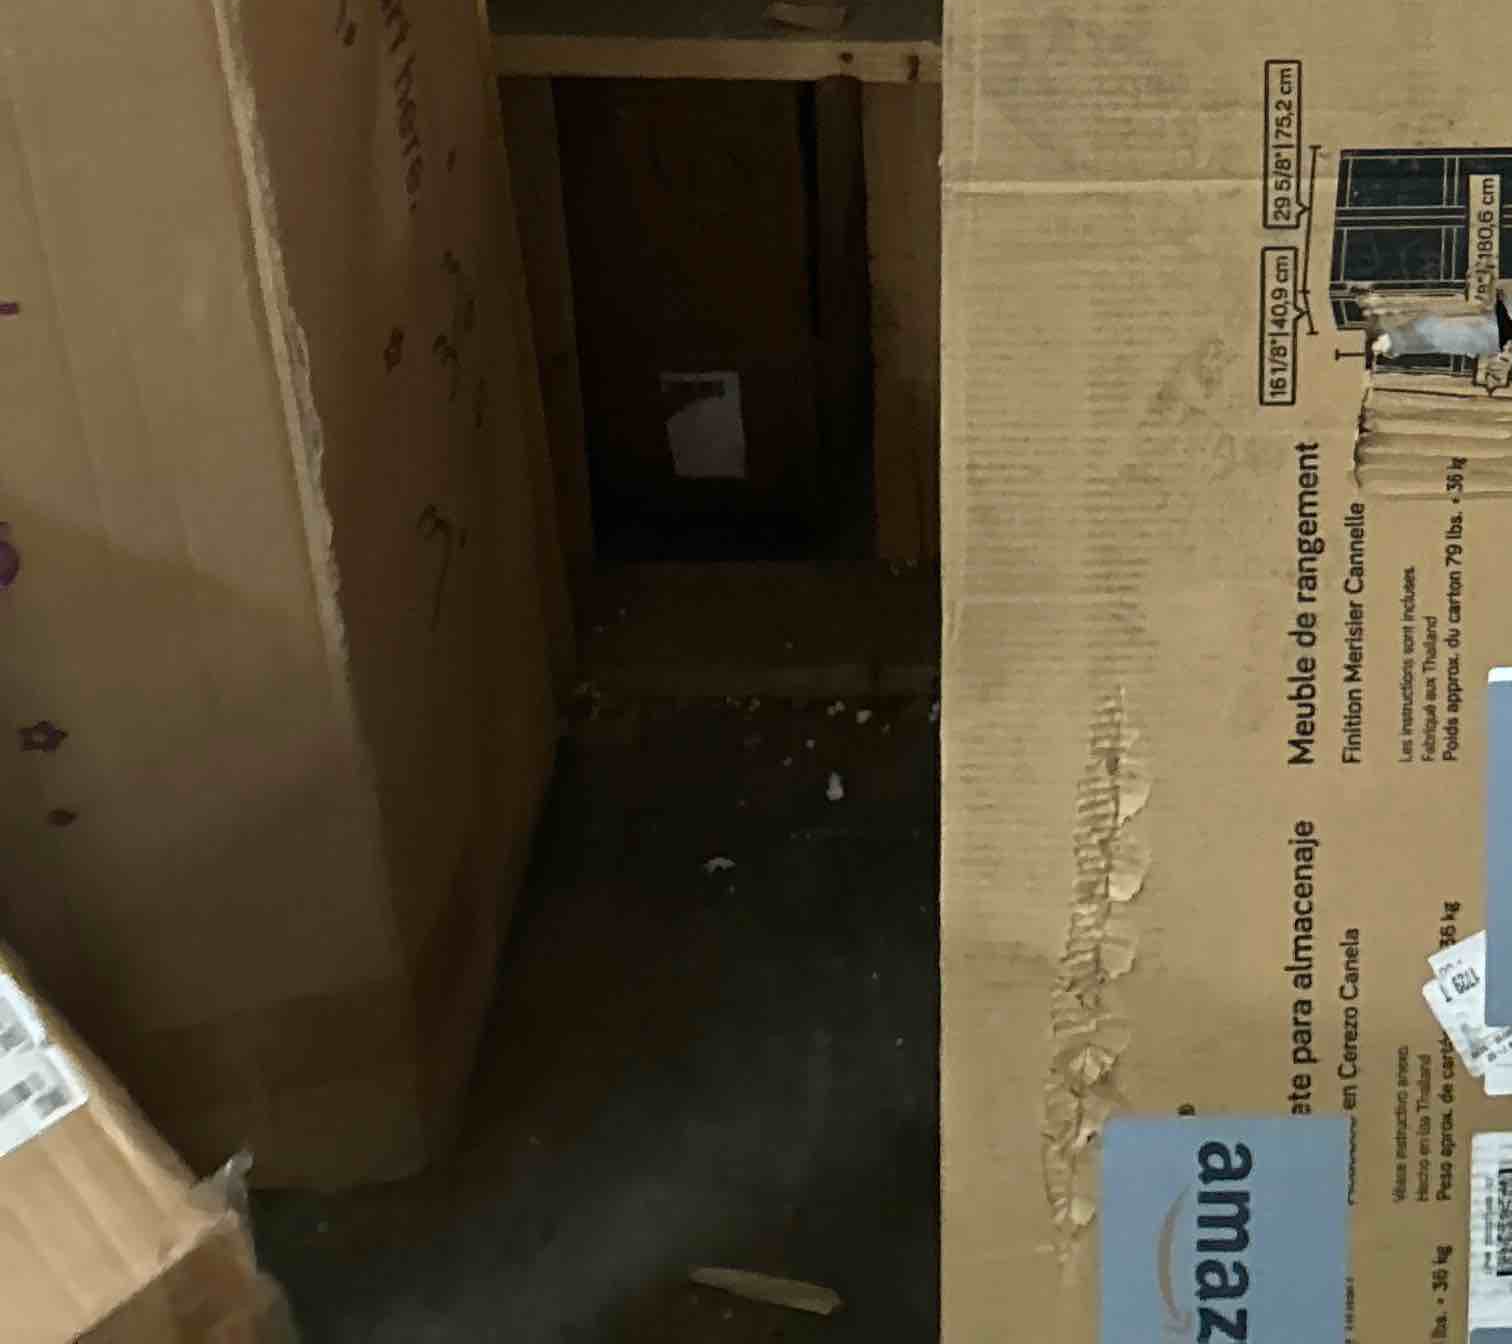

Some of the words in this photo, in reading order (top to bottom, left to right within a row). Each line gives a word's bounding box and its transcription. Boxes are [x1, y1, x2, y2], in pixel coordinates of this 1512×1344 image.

[1279, 68, 1292, 95] cm
[1275, 196, 1290, 221] 29
[1480, 177, 1493, 205] cm
[1275, 255, 1289, 283] cm
[1446, 473, 1464, 491] 36
[1294, 442, 1324, 603] rangement
[1445, 512, 1463, 539] lbs.
[1345, 503, 1365, 594] Cannelle
[1445, 544, 1463, 567] 79
[1446, 571, 1462, 623] carton
[1289, 612, 1317, 647] de
[1344, 601, 1364, 682] Merisier
[1403, 626, 1415, 654] sont
[1423, 616, 1438, 672] Thailand
[1444, 628, 1460, 647] du
[1400, 659, 1415, 736] instructions
[1426, 678, 1437, 700] aux
[1446, 655, 1464, 713] approx.
[1287, 657, 1316, 765] Meuble
[1342, 689, 1363, 764] Finition
[1399, 740, 1414, 762] Les
[1442, 717, 1460, 761] Poids
[1284, 820, 1320, 990] almacenaje
[1439, 901, 1460, 921] kg
[1339, 928, 1360, 1000] Canela
[1291, 998, 1317, 1064] para
[1337, 1007, 1359, 1080] Cerezo
[1343, 1085, 1358, 1110] en
[1438, 1083, 1454, 1103] de
[1436, 1162, 1453, 1201] Peso
[1195, 1140, 1253, 1344] amaz
[1433, 1246, 1452, 1264] kg
[1432, 1269, 1449, 1292] 36
